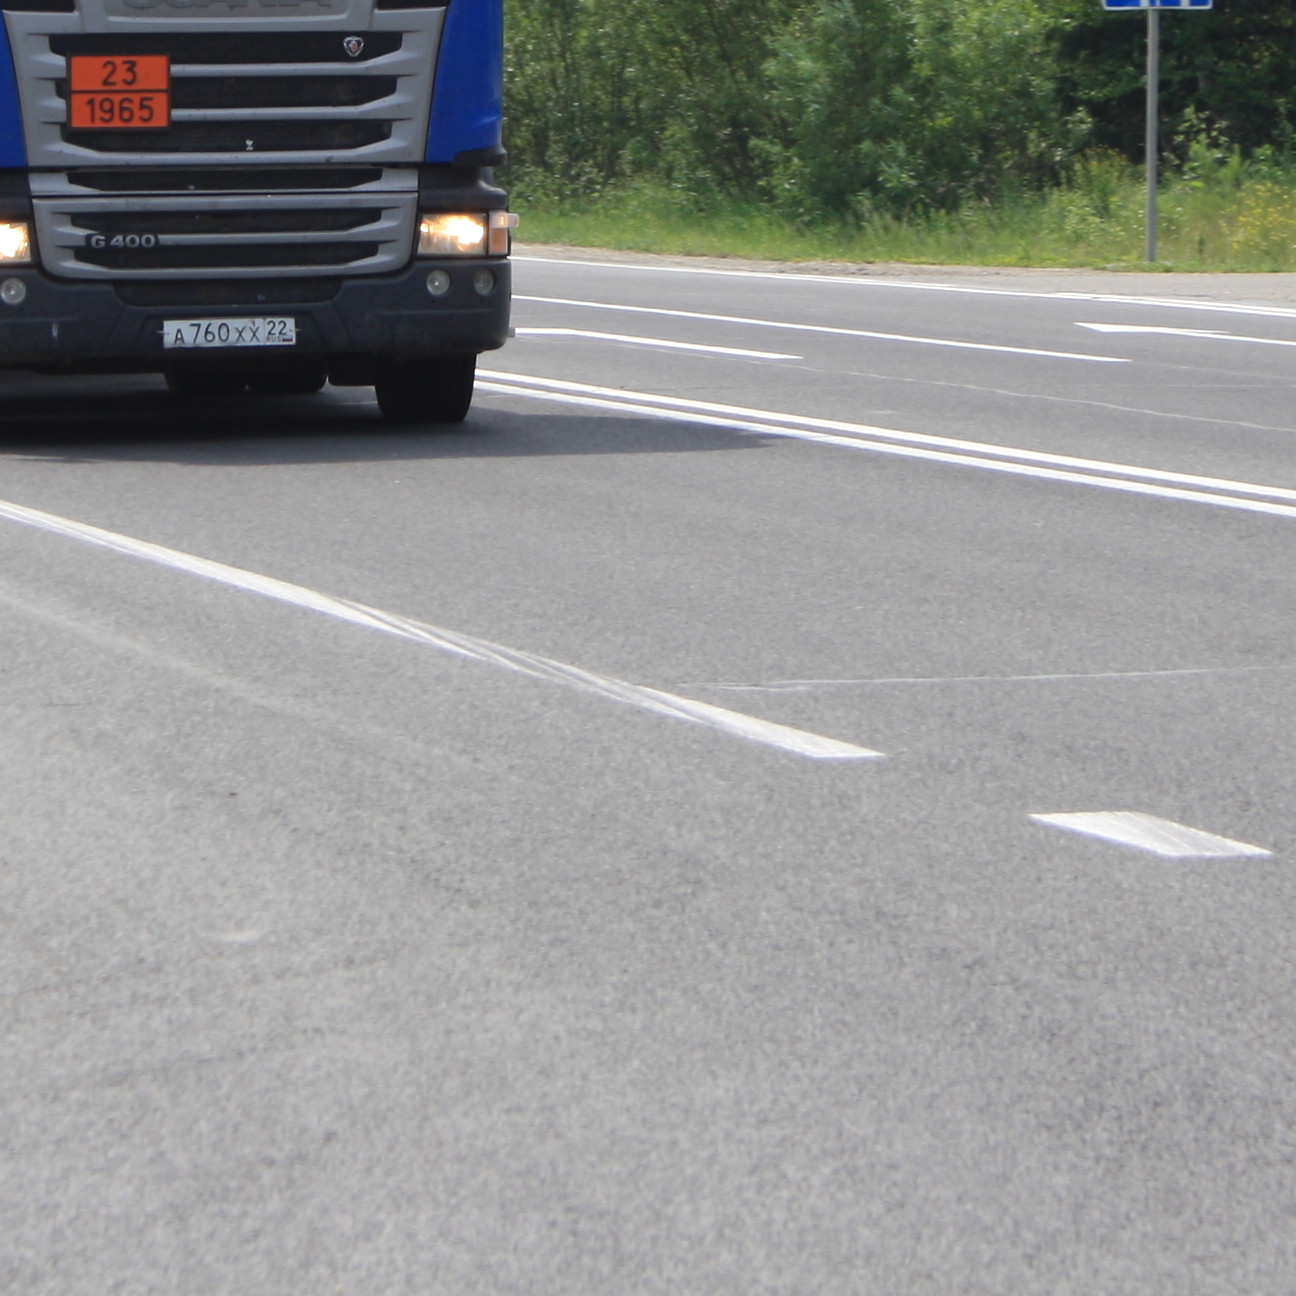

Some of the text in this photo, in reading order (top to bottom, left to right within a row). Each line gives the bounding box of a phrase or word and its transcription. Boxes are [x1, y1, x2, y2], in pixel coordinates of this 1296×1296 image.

[101, 60, 137, 86] 23
[86, 97, 154, 123] 1965
[110, 234, 156, 248] 400
